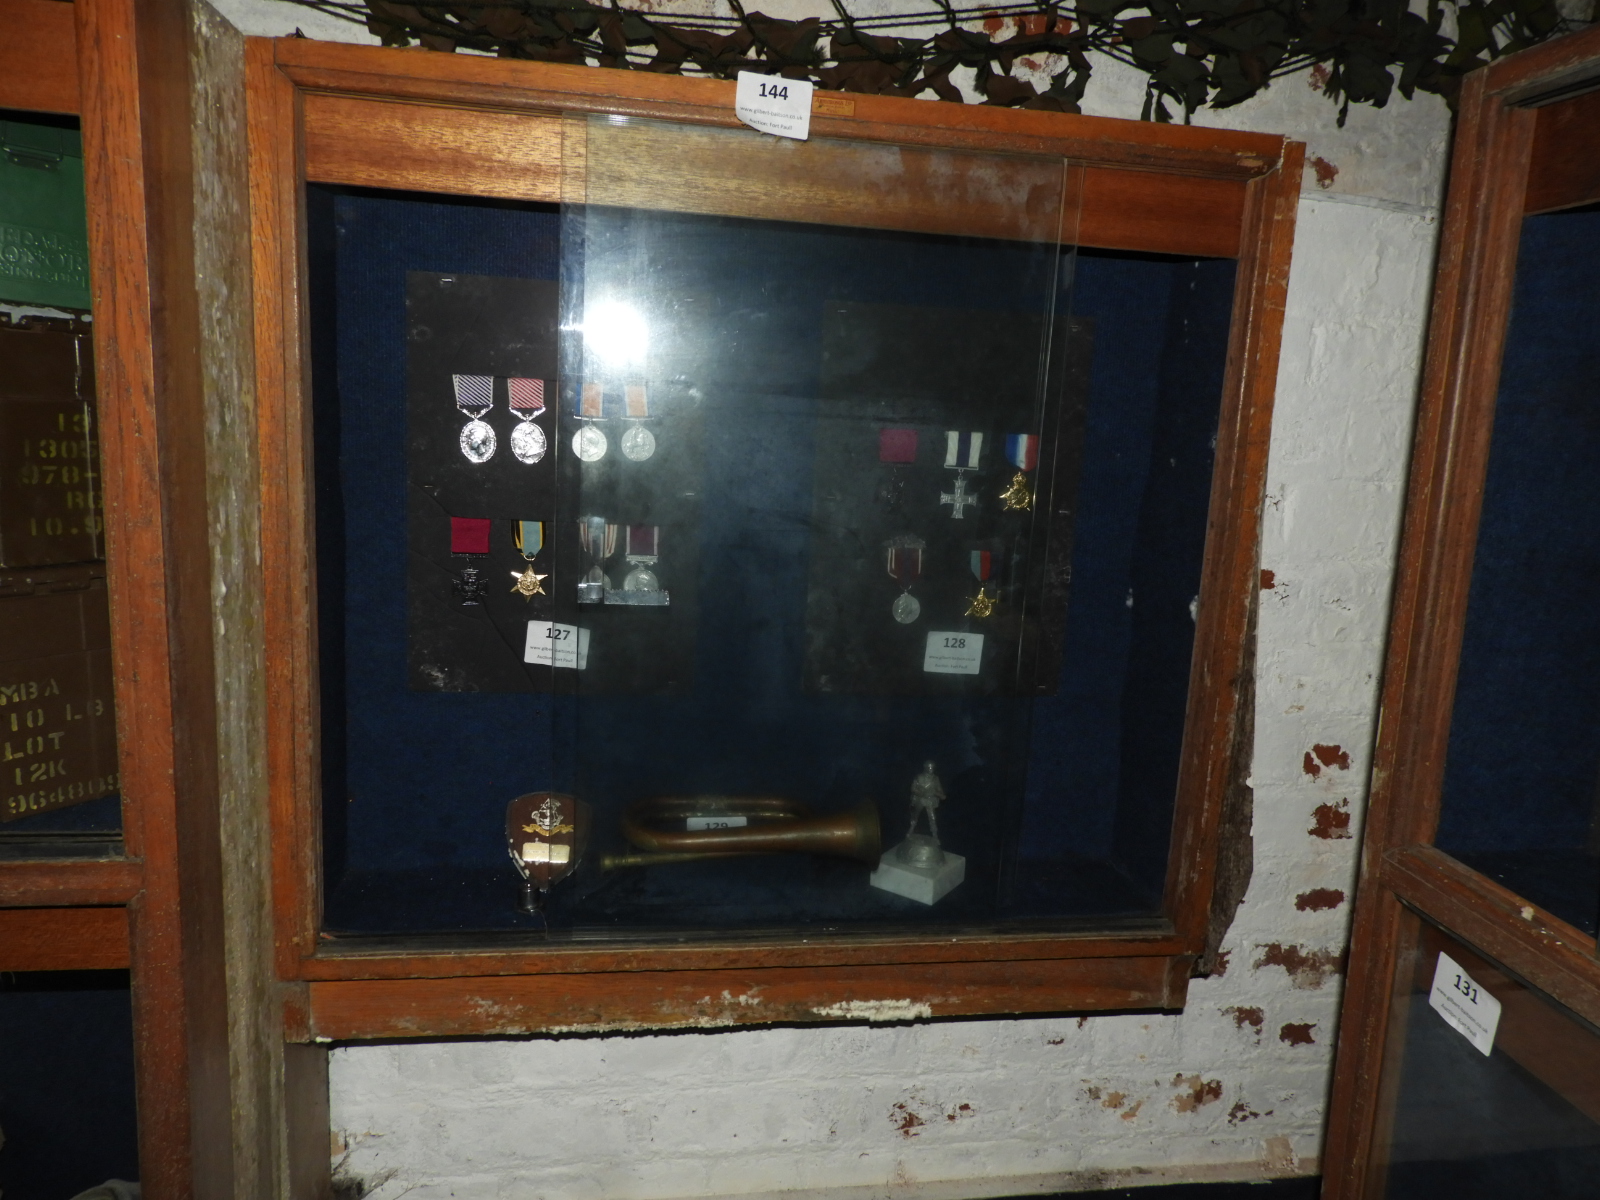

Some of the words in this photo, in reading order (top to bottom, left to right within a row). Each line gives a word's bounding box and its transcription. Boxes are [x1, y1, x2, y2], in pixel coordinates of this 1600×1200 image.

[759, 83, 788, 100] 144
[546, 627, 571, 641] 127
[943, 637, 966, 649] 128
[11, 708, 44, 732] 10
[4, 731, 65, 761] LOT
[15, 759, 67, 786] 12K
[1453, 974, 1478, 1006] 131
